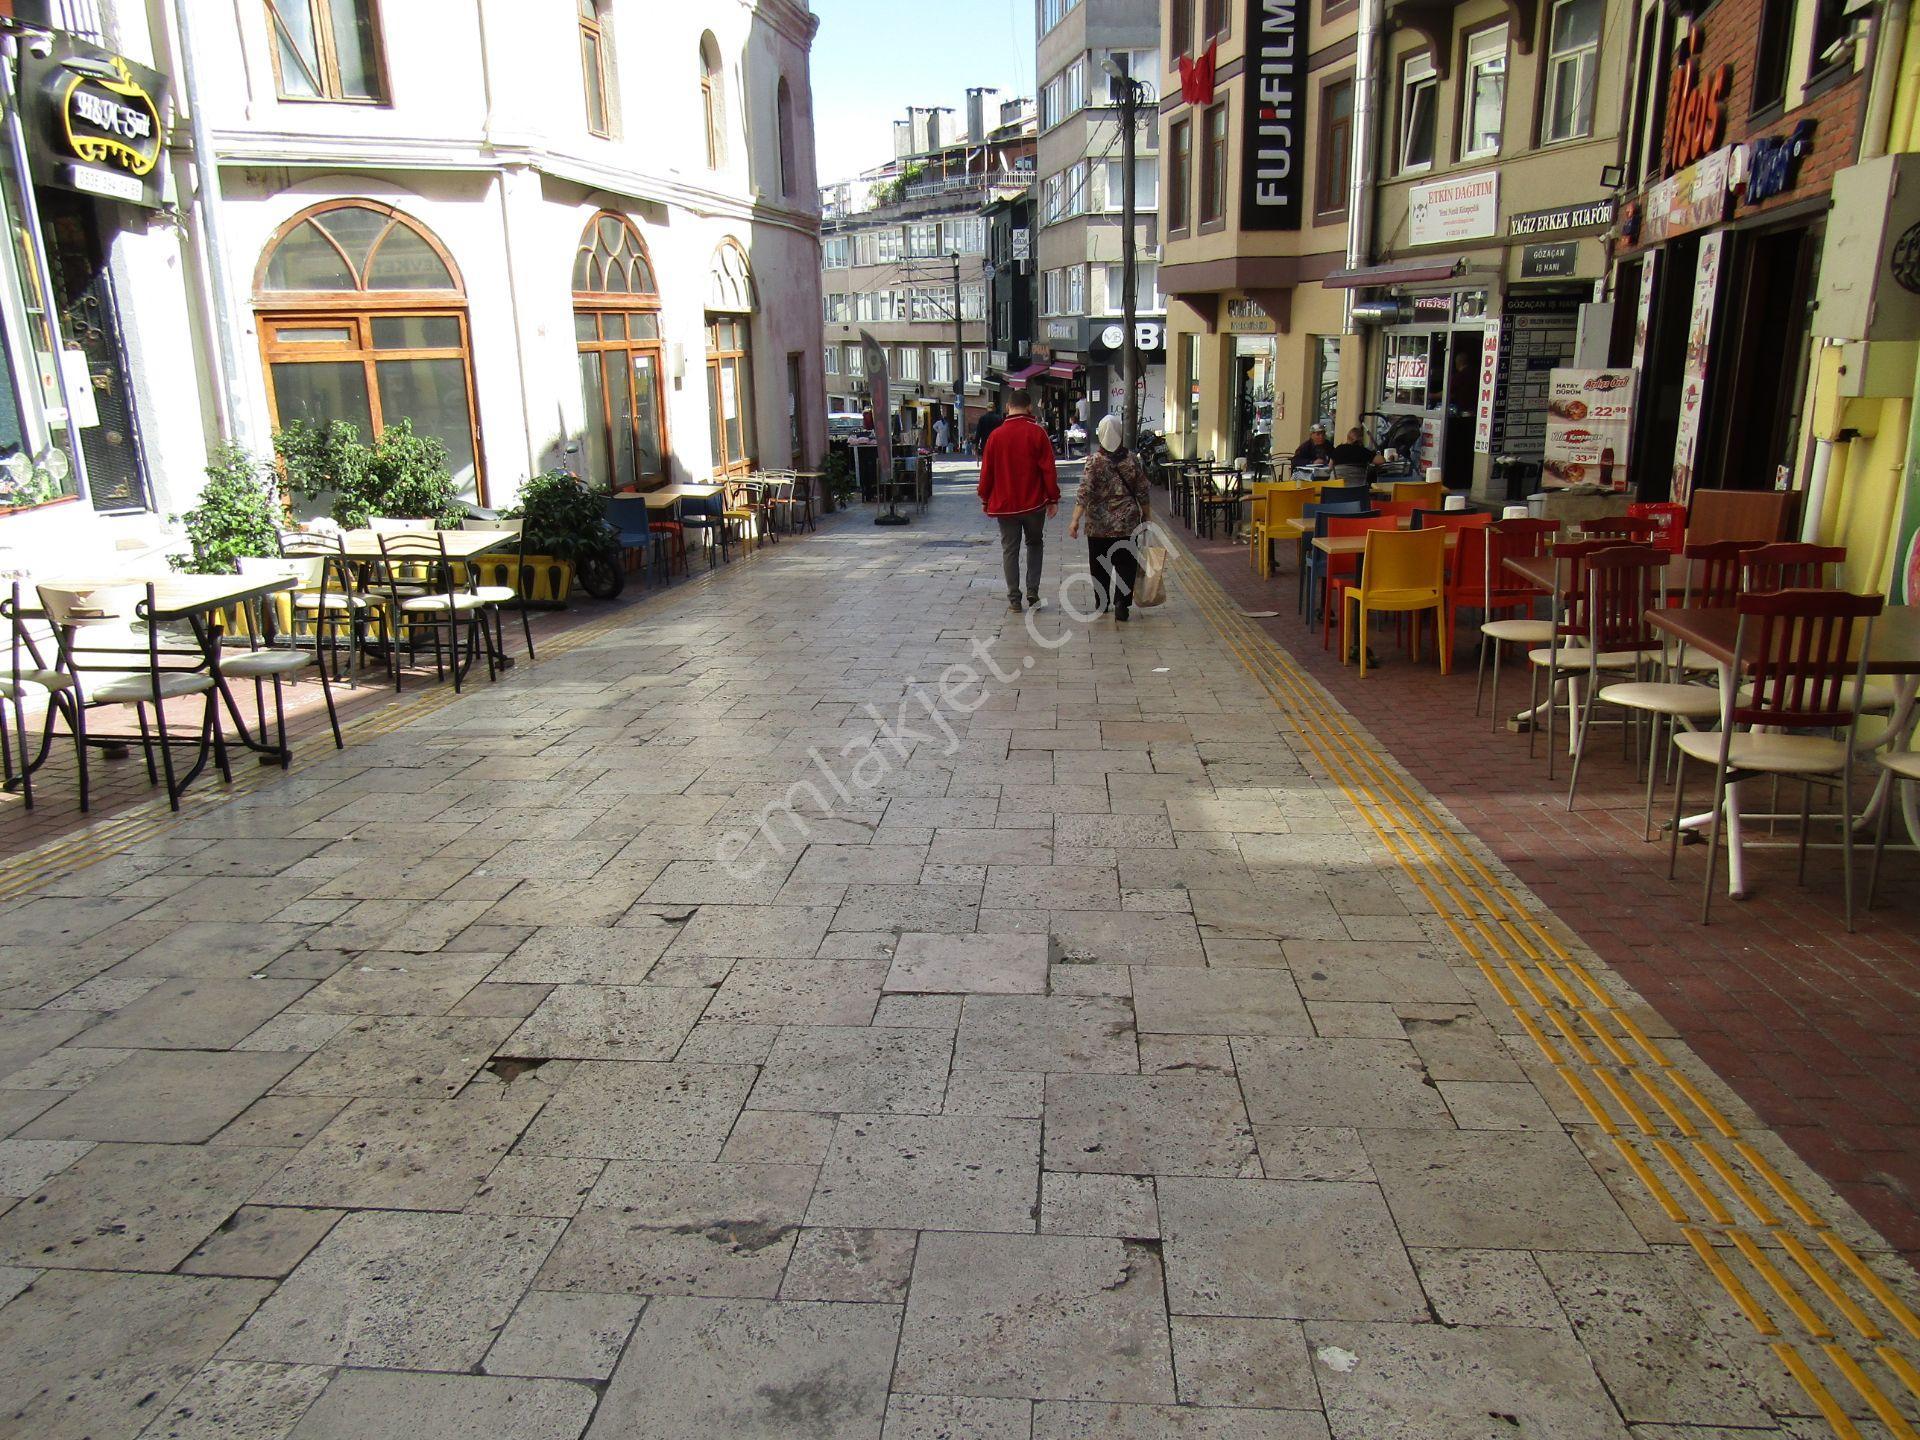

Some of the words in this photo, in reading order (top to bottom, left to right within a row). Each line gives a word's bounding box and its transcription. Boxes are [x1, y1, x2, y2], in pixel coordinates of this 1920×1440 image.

[1256, 0, 1296, 206] FUJIFILM
[1428, 186, 1453, 204] ETKİN
[1455, 179, 1492, 201] DAĞITIM
[1511, 217, 1536, 235] YAĞIZ
[1537, 212, 1569, 232] ERKEK
[1533, 248, 1565, 260] GÖZAÇAN
[1536, 263, 1543, 272] İŞ
[1479, 355, 1494, 437] DÖNER
